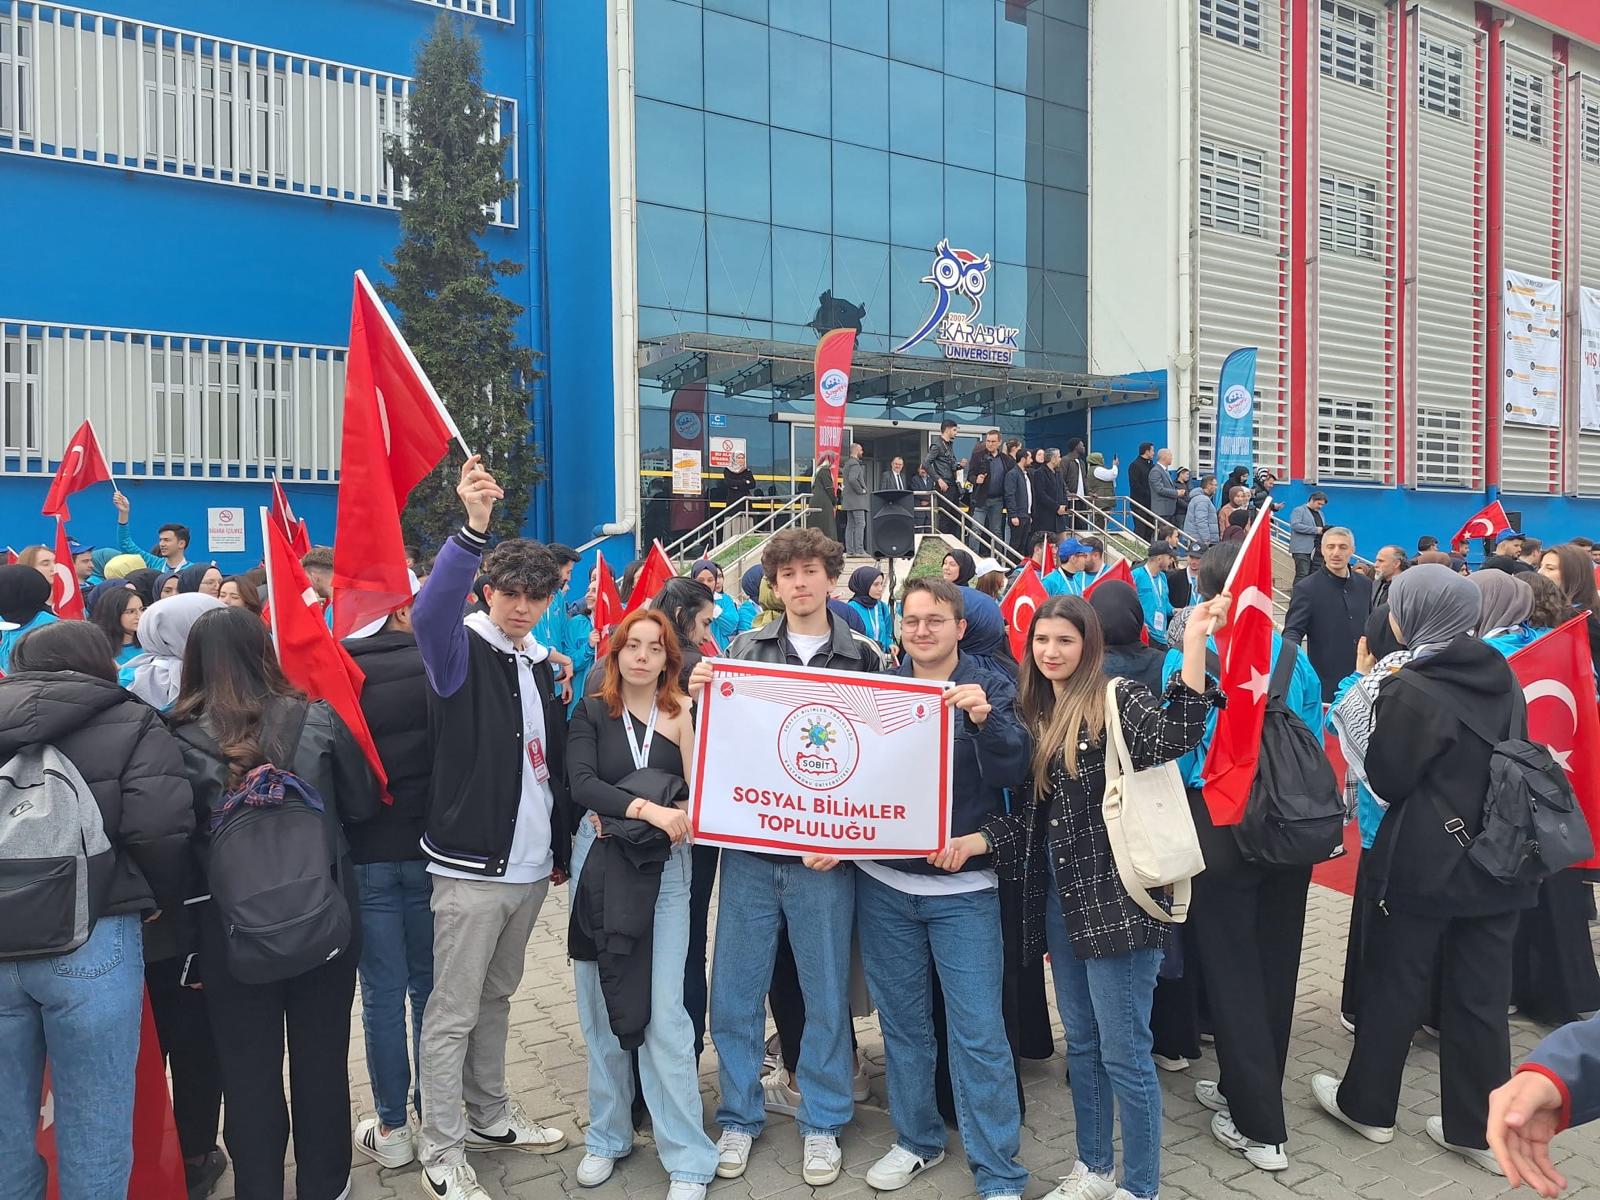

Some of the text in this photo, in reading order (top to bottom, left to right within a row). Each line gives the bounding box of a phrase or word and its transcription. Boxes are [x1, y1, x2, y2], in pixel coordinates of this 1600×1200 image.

[943, 322, 1018, 348] KARABÜK
[802, 759, 830, 770] SOBİT
[732, 786, 906, 820] SOSYAL BİLİMLER
[757, 813, 876, 841] TOPLULUĞU
